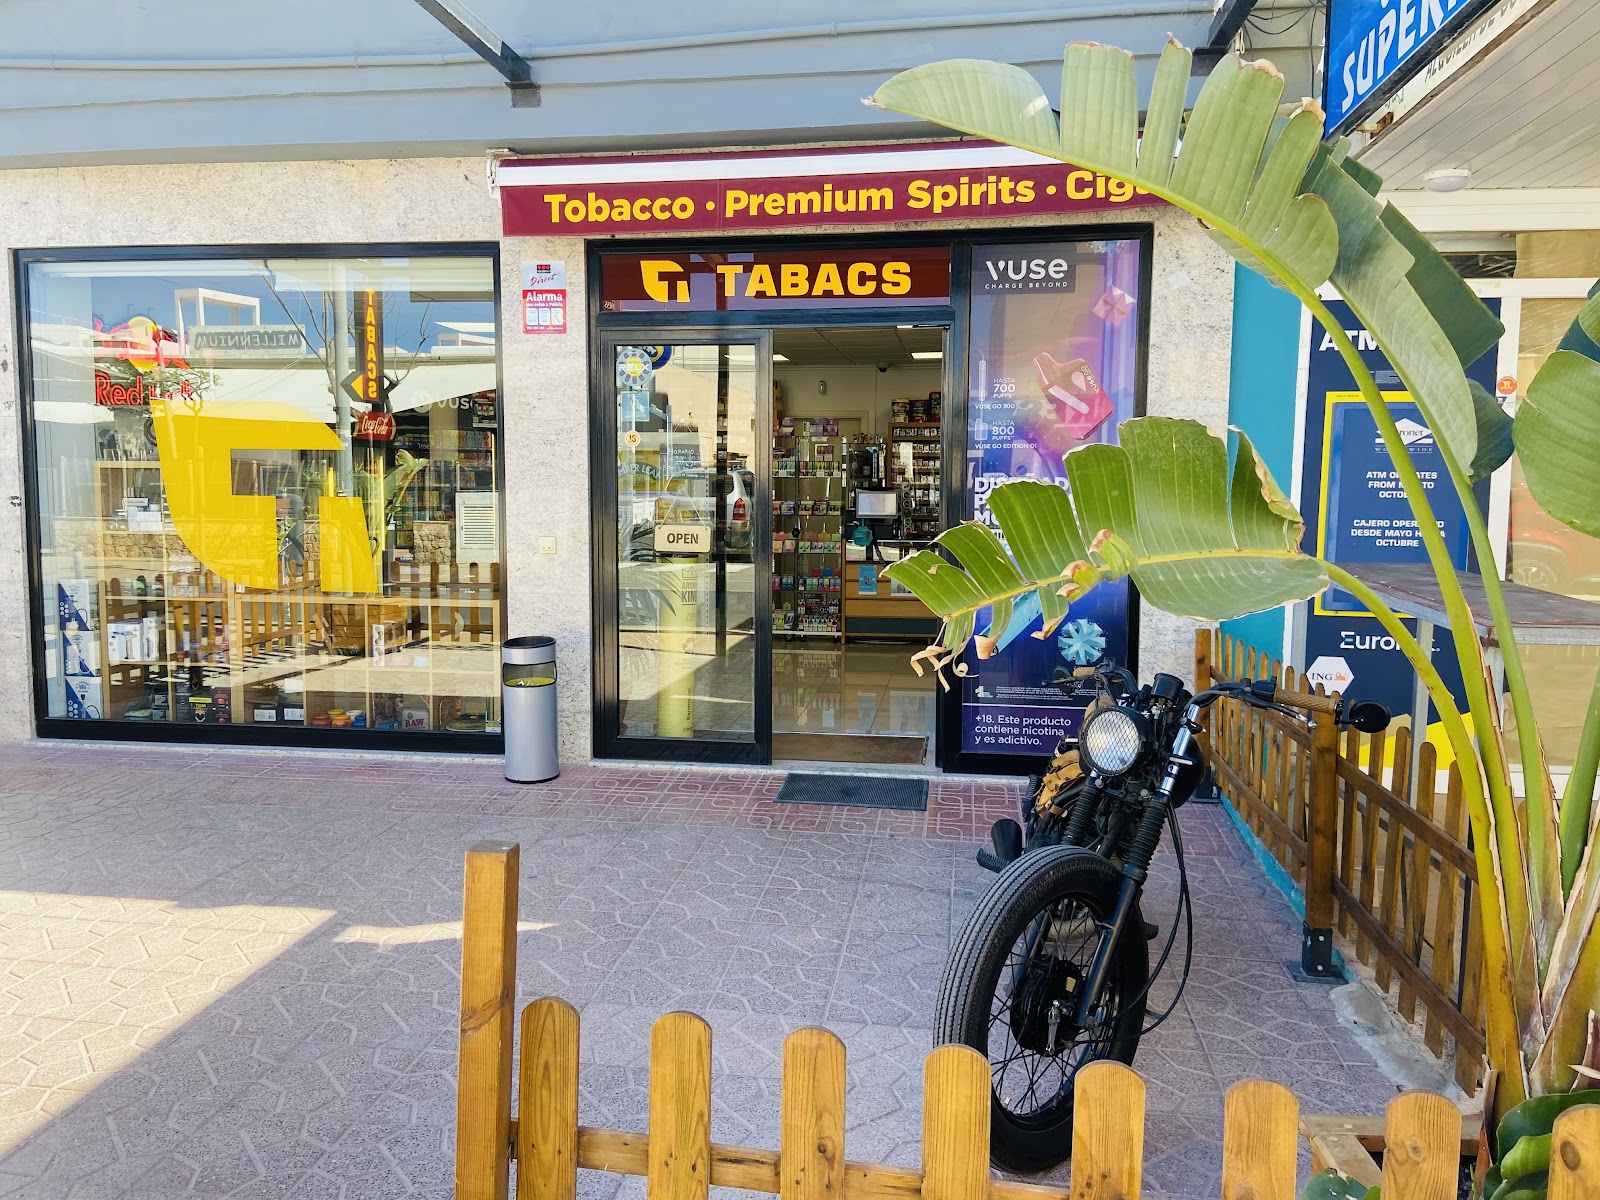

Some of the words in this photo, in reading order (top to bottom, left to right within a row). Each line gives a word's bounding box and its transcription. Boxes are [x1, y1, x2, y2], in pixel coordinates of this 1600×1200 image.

[543, 192, 695, 223] Tobacco
[725, 183, 894, 218] Premium
[907, 175, 1036, 213] Spirits
[716, 260, 911, 297] TABACS
[1028, 281, 1068, 289] BEYOND
[526, 291, 563, 302] Alarma
[95, 370, 145, 406] Red
[993, 383, 1016, 393] 700
[437, 397, 473, 410] vus
[992, 426, 1015, 435] 800
[1366, 471, 1387, 479] ATM
[1368, 481, 1395, 489] FROM
[1421, 481, 1434, 489] TO
[1353, 519, 1390, 527] CAJERO
[666, 532, 699, 544] OPEN
[1350, 529, 1382, 537] DESDE
[1375, 539, 1419, 547] OCTUBRE
[1311, 672, 1333, 681] ING
[404, 717, 425, 728] RAW
[975, 714, 995, 724] +18.
[998, 715, 1020, 724] Este
[1022, 716, 1071, 727] producto
[975, 725, 1020, 735] contiene
[1022, 726, 1065, 736] nicotina
[975, 736, 982, 745] y
[984, 736, 995, 744] es
[998, 735, 1042, 745] adictivo.
